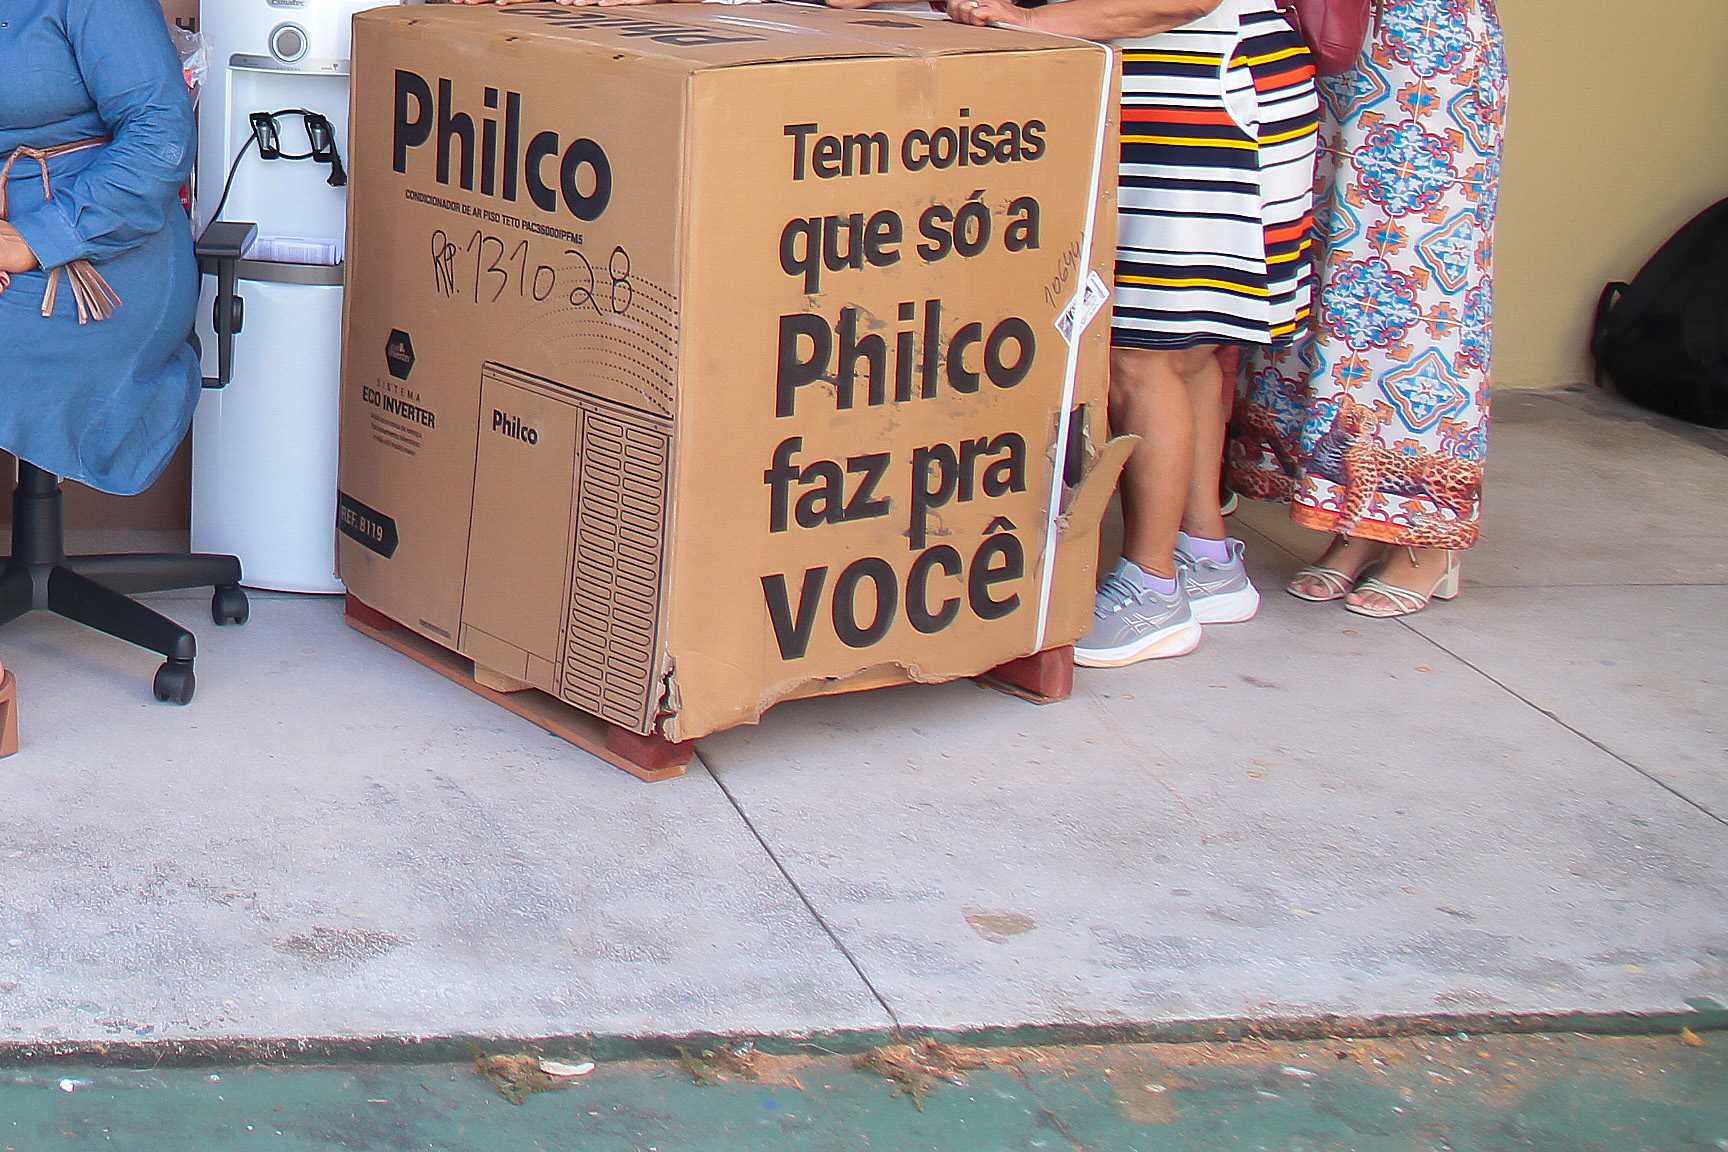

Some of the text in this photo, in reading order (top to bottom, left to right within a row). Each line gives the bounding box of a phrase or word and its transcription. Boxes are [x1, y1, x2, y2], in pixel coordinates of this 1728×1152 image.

[392, 68, 613, 223] Philco
[783, 107, 1047, 181] Tem coisas
[405, 189, 461, 213] CONDICIONADOR
[461, 204, 473, 216] DE
[472, 207, 483, 218] AR
[483, 210, 501, 223] PISO
[502, 214, 521, 229] TETO
[779, 189, 1041, 295] que só a
[775, 299, 1036, 418] Philco
[362, 386, 381, 407] ECO
[382, 394, 436, 430] INVERTER
[492, 408, 539, 445] Philco
[763, 431, 1027, 551] faz pra
